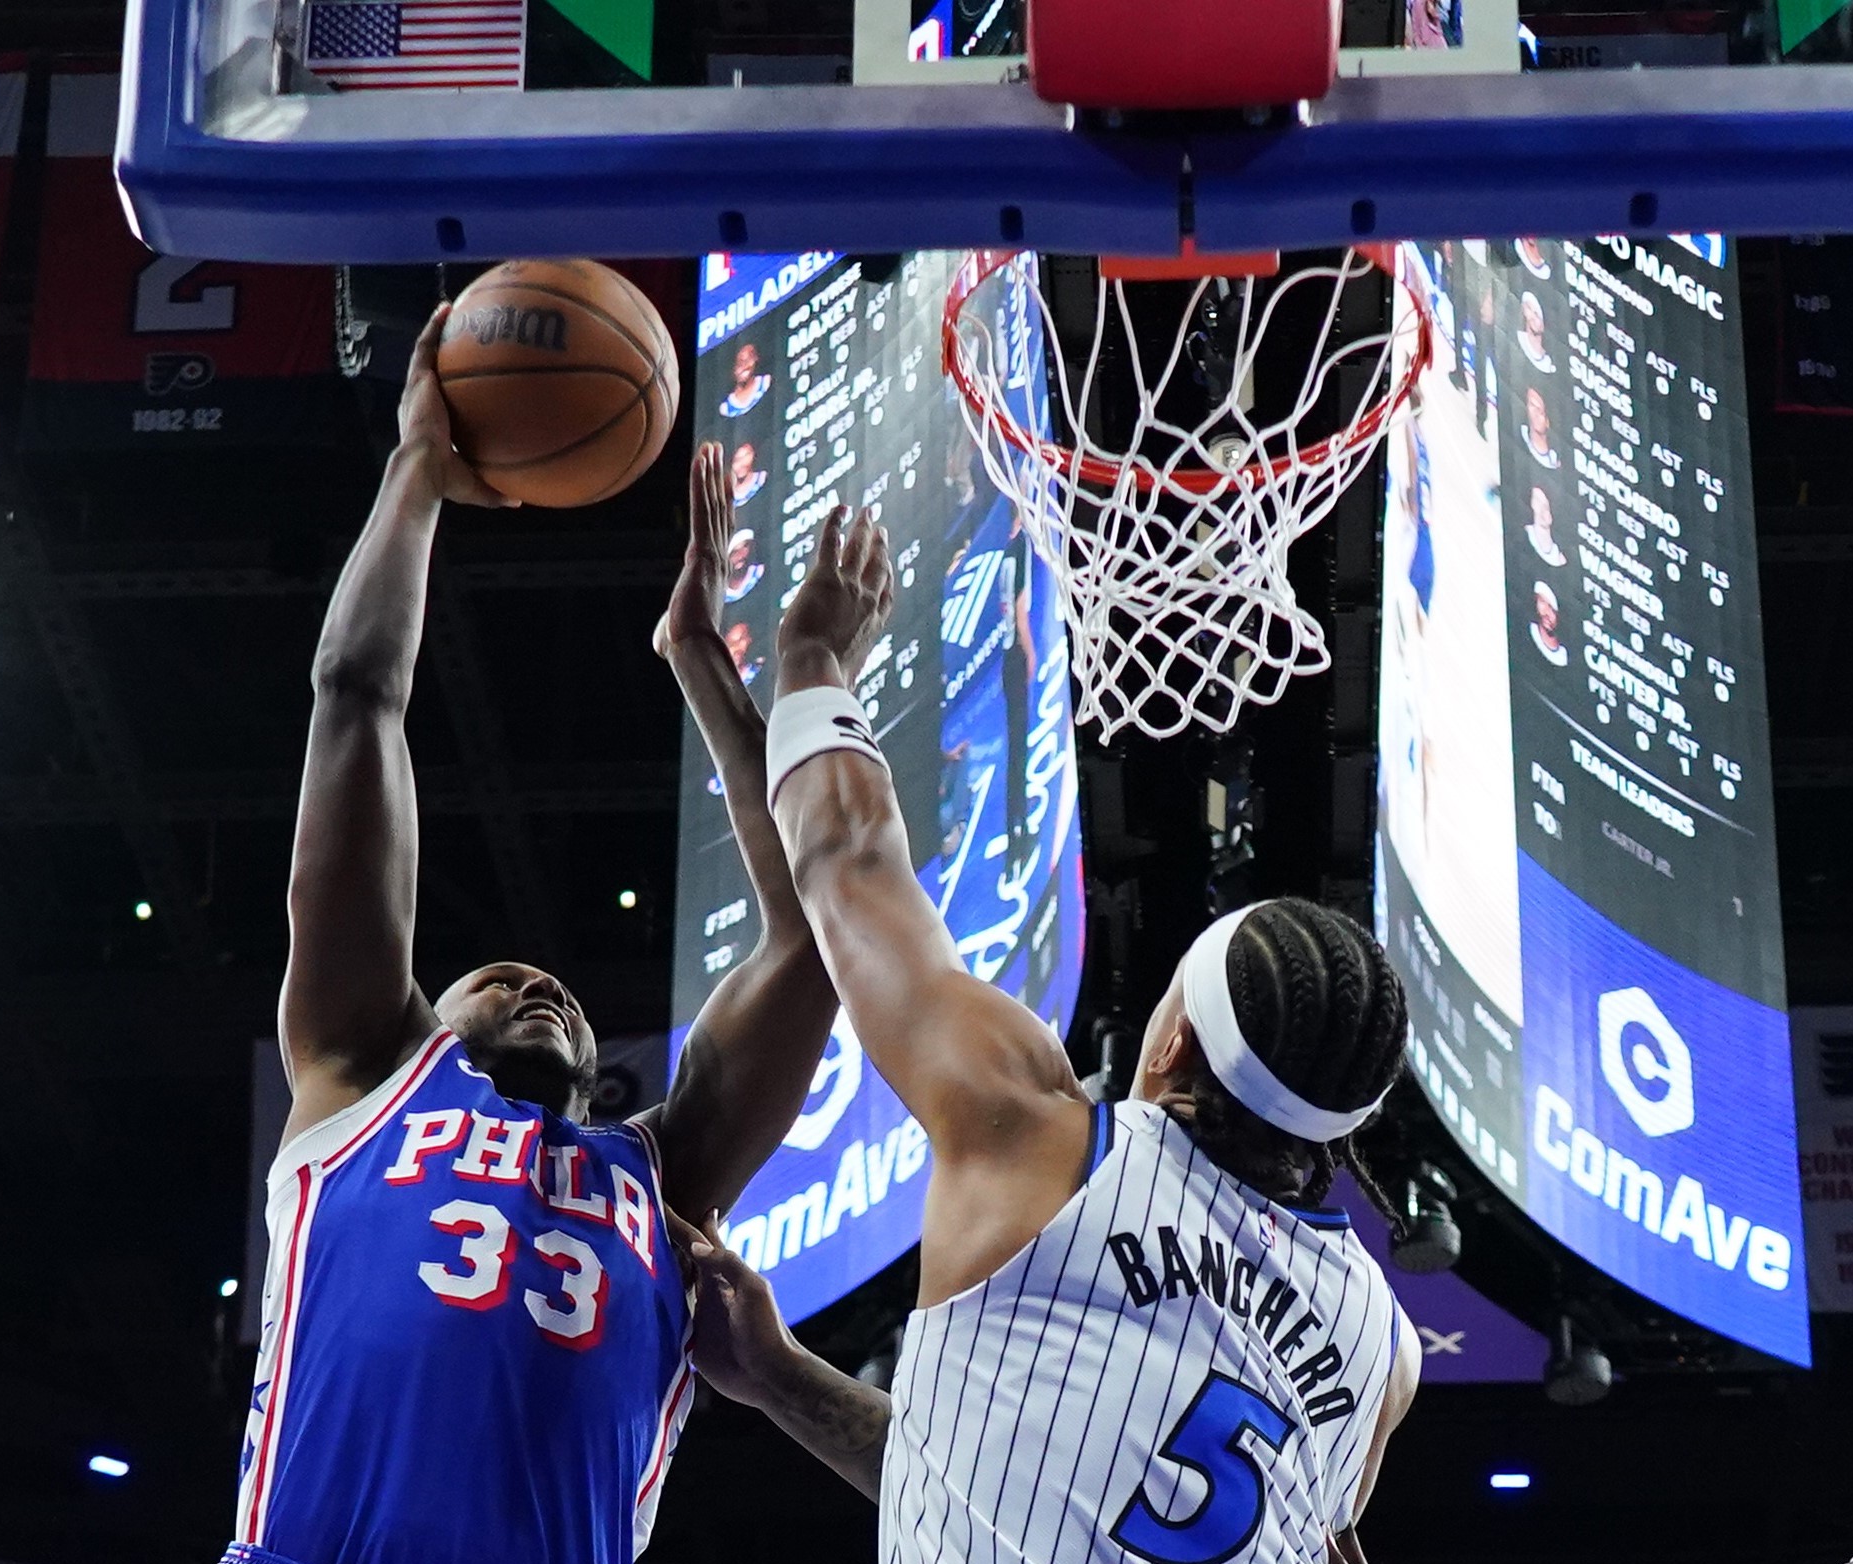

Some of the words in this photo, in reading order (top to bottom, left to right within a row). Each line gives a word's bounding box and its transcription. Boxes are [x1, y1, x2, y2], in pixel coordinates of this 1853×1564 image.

[698, 250, 835, 348] PHILADEL
[1564, 261, 1616, 318] BANE
[1634, 245, 1725, 321] MAGIC
[786, 287, 859, 358] MAXEY
[1569, 354, 1634, 418] SUGGS
[1645, 350, 1678, 380] AST
[1689, 376, 1719, 405] FLS
[1573, 448, 1681, 538] BANCHERO
[1650, 442, 1684, 472] AST
[1695, 468, 1725, 496] FLS
[781, 488, 841, 545] BONA
[1578, 543, 1666, 623] WAGNER
[1655, 536, 1690, 566] AST
[1700, 561, 1731, 590] FLS
[1583, 643, 1661, 714] CARTER
[1661, 631, 1696, 662] AST
[1706, 655, 1737, 685] FLS
[1568, 737, 1620, 792] TEAM
[1618, 773, 1697, 840] LEADERS
[1665, 728, 1702, 761] AST
[1711, 752, 1743, 783] FLS
[1533, 1084, 1792, 1292] ComAve
[418, 1198, 611, 1354] 33
[1108, 1225, 1355, 1428] BANCHERO
